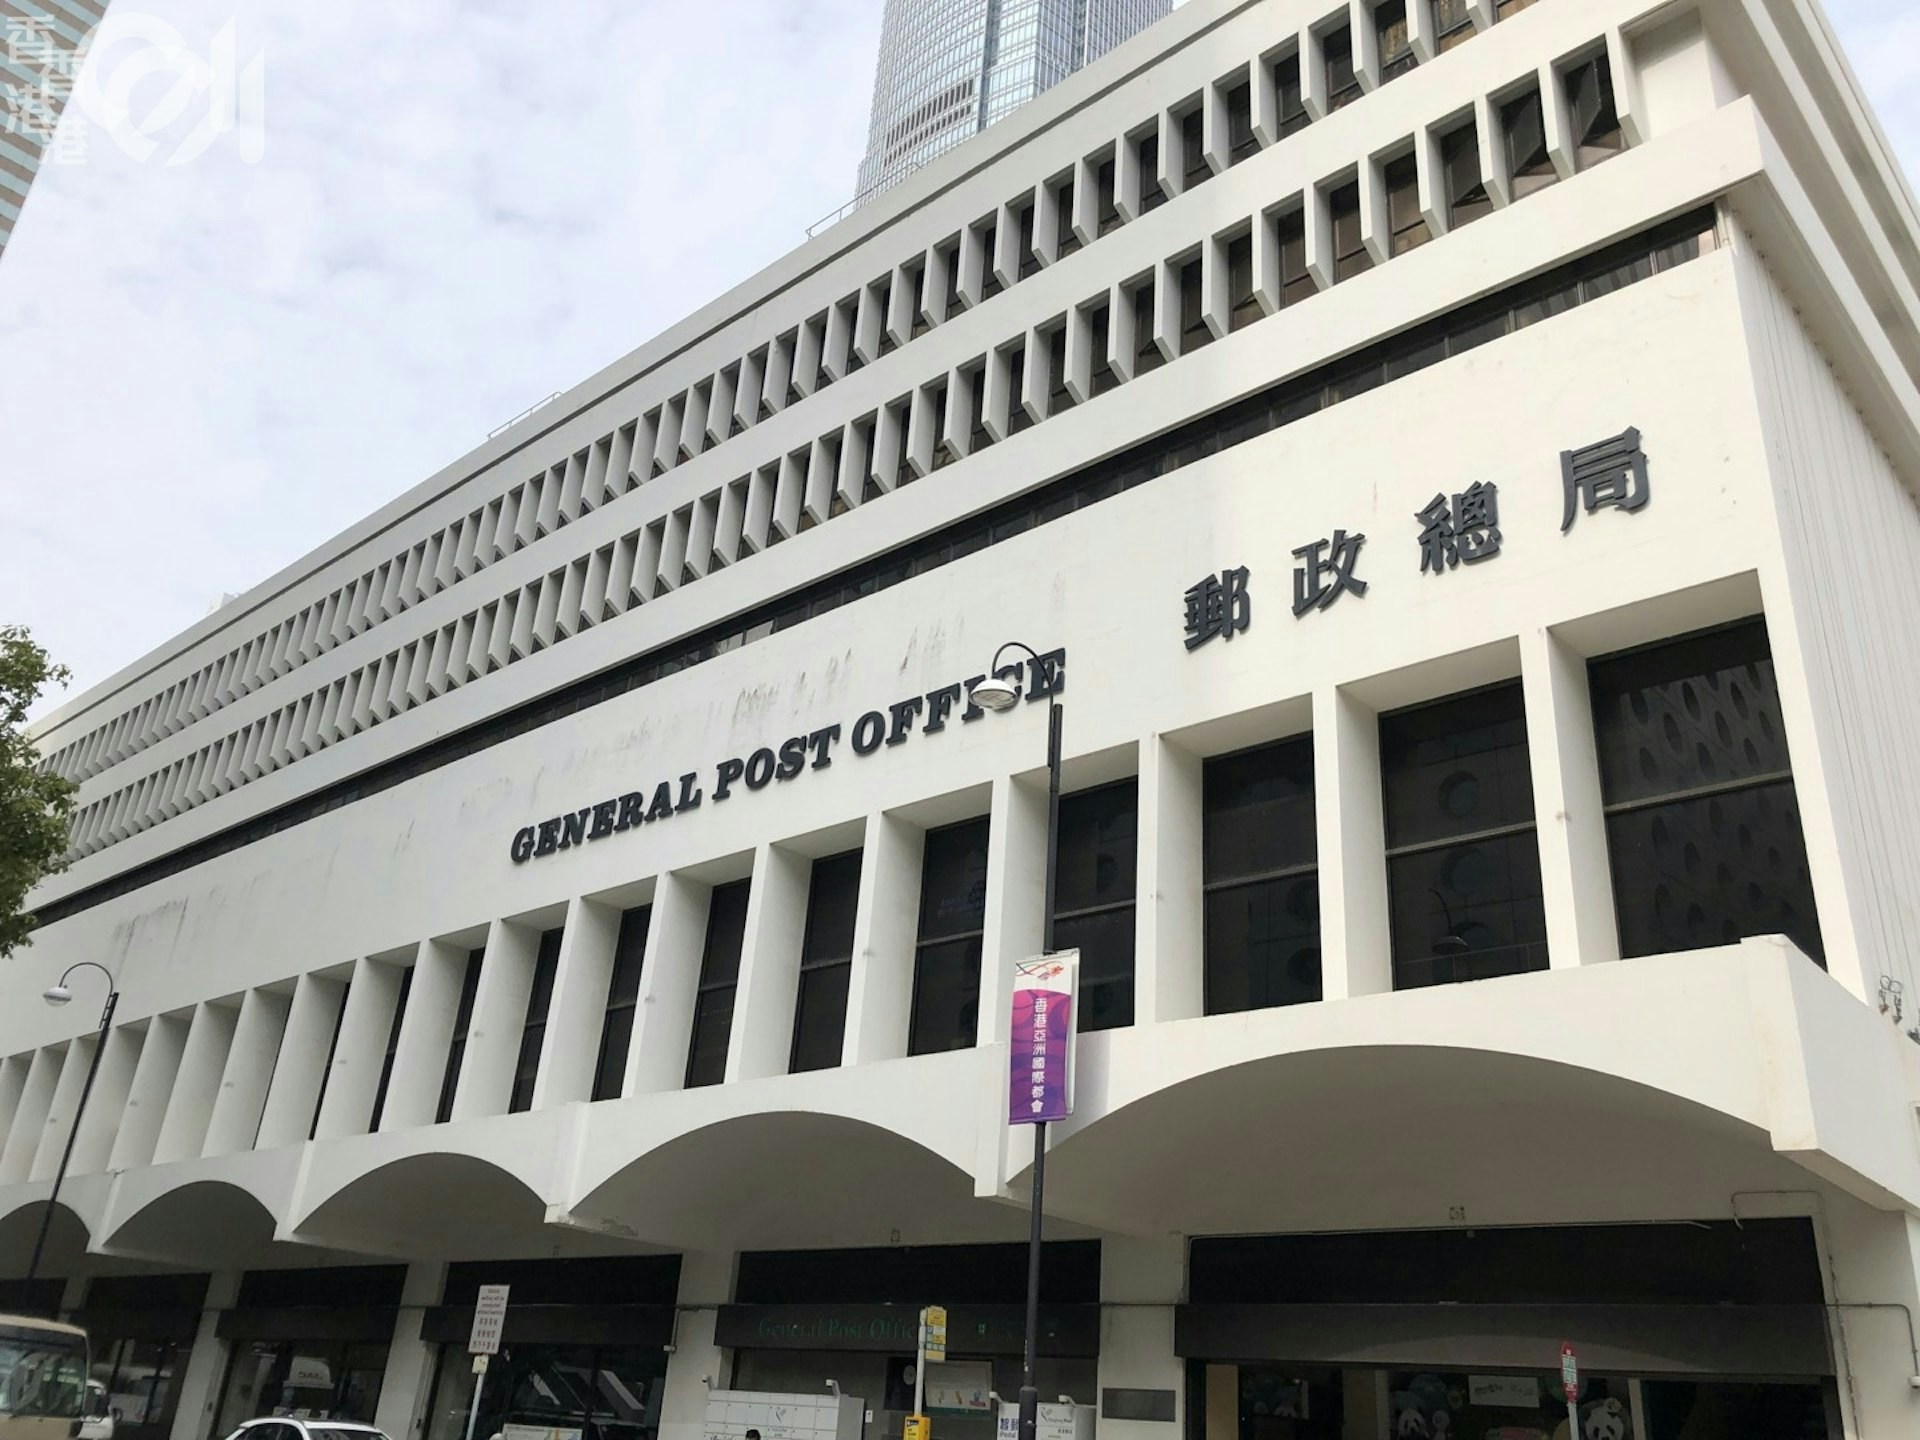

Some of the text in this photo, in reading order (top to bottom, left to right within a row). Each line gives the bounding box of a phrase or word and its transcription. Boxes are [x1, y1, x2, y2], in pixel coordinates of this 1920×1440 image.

[1184, 426, 1651, 652] 郵政總局
[510, 771, 702, 863] GENERAL
[711, 723, 841, 801] POST
[1030, 998, 1048, 1113] 香港亞洲國際都會
[869, 1318, 915, 1340] Offic
